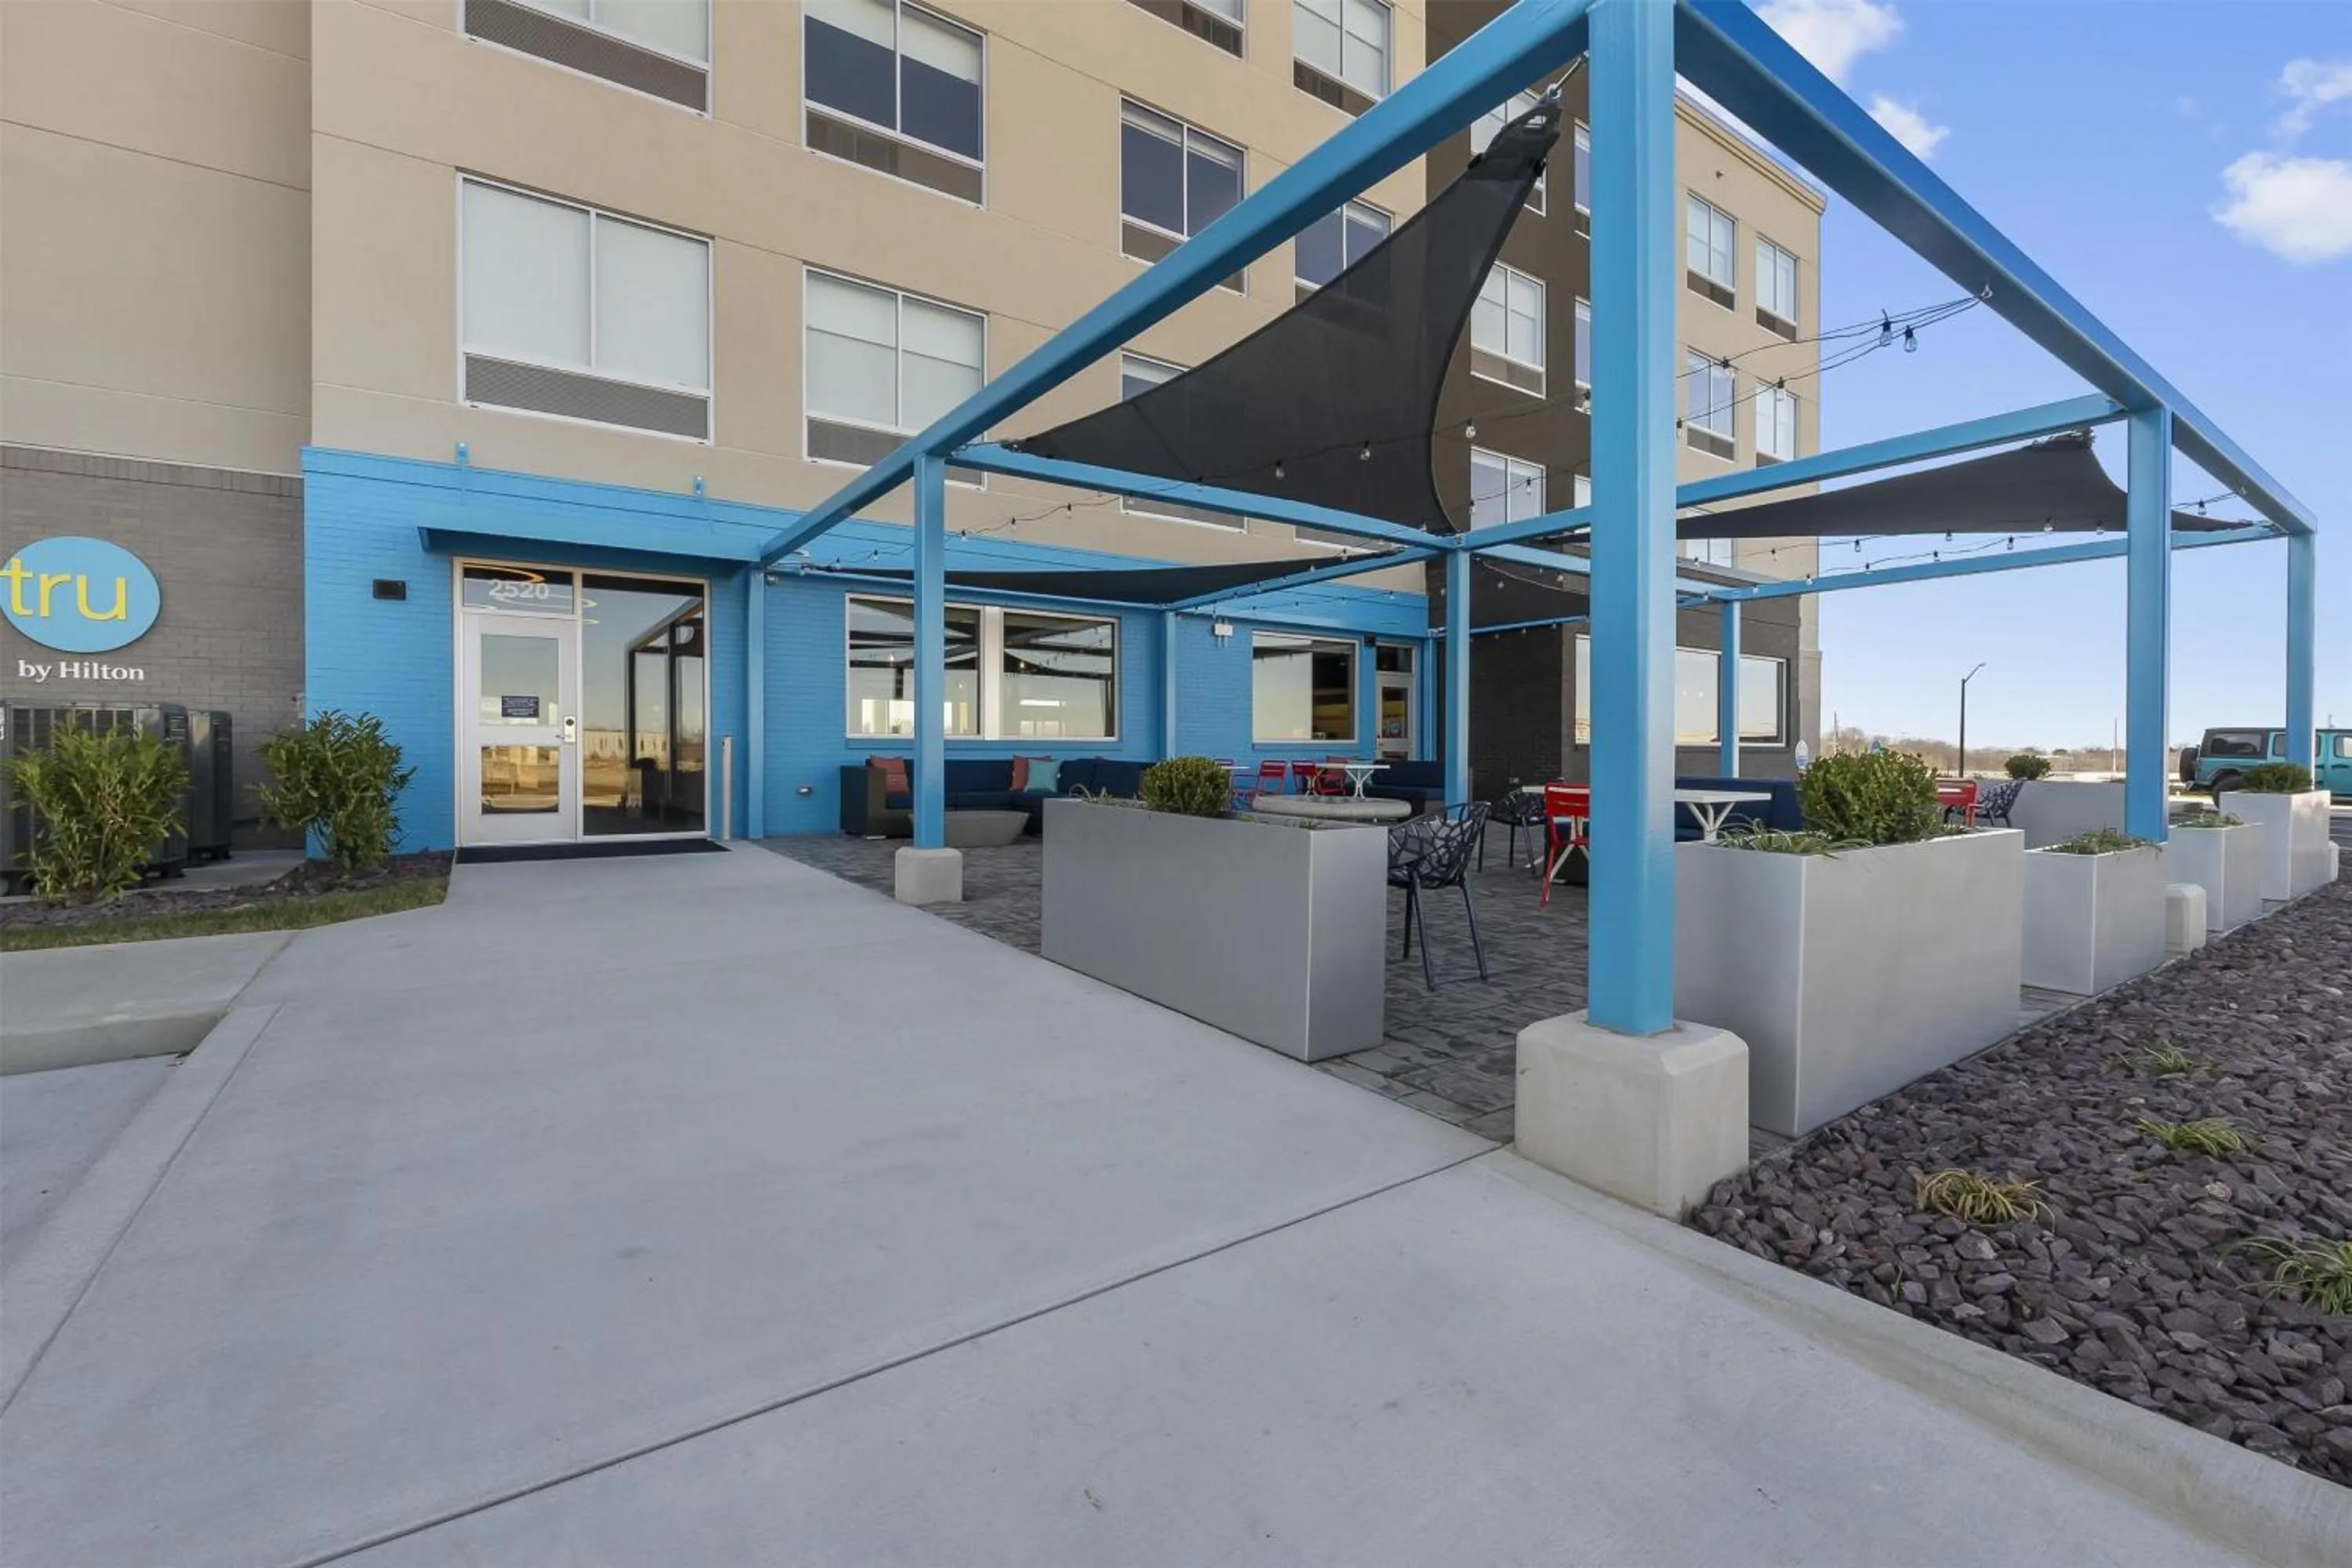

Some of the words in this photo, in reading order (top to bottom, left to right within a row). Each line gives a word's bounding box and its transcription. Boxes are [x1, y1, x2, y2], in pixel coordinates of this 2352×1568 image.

[0, 557, 126, 620] tru
[488, 579, 549, 599] 2520
[18, 659, 53, 683] by
[59, 661, 144, 681] Hilton
